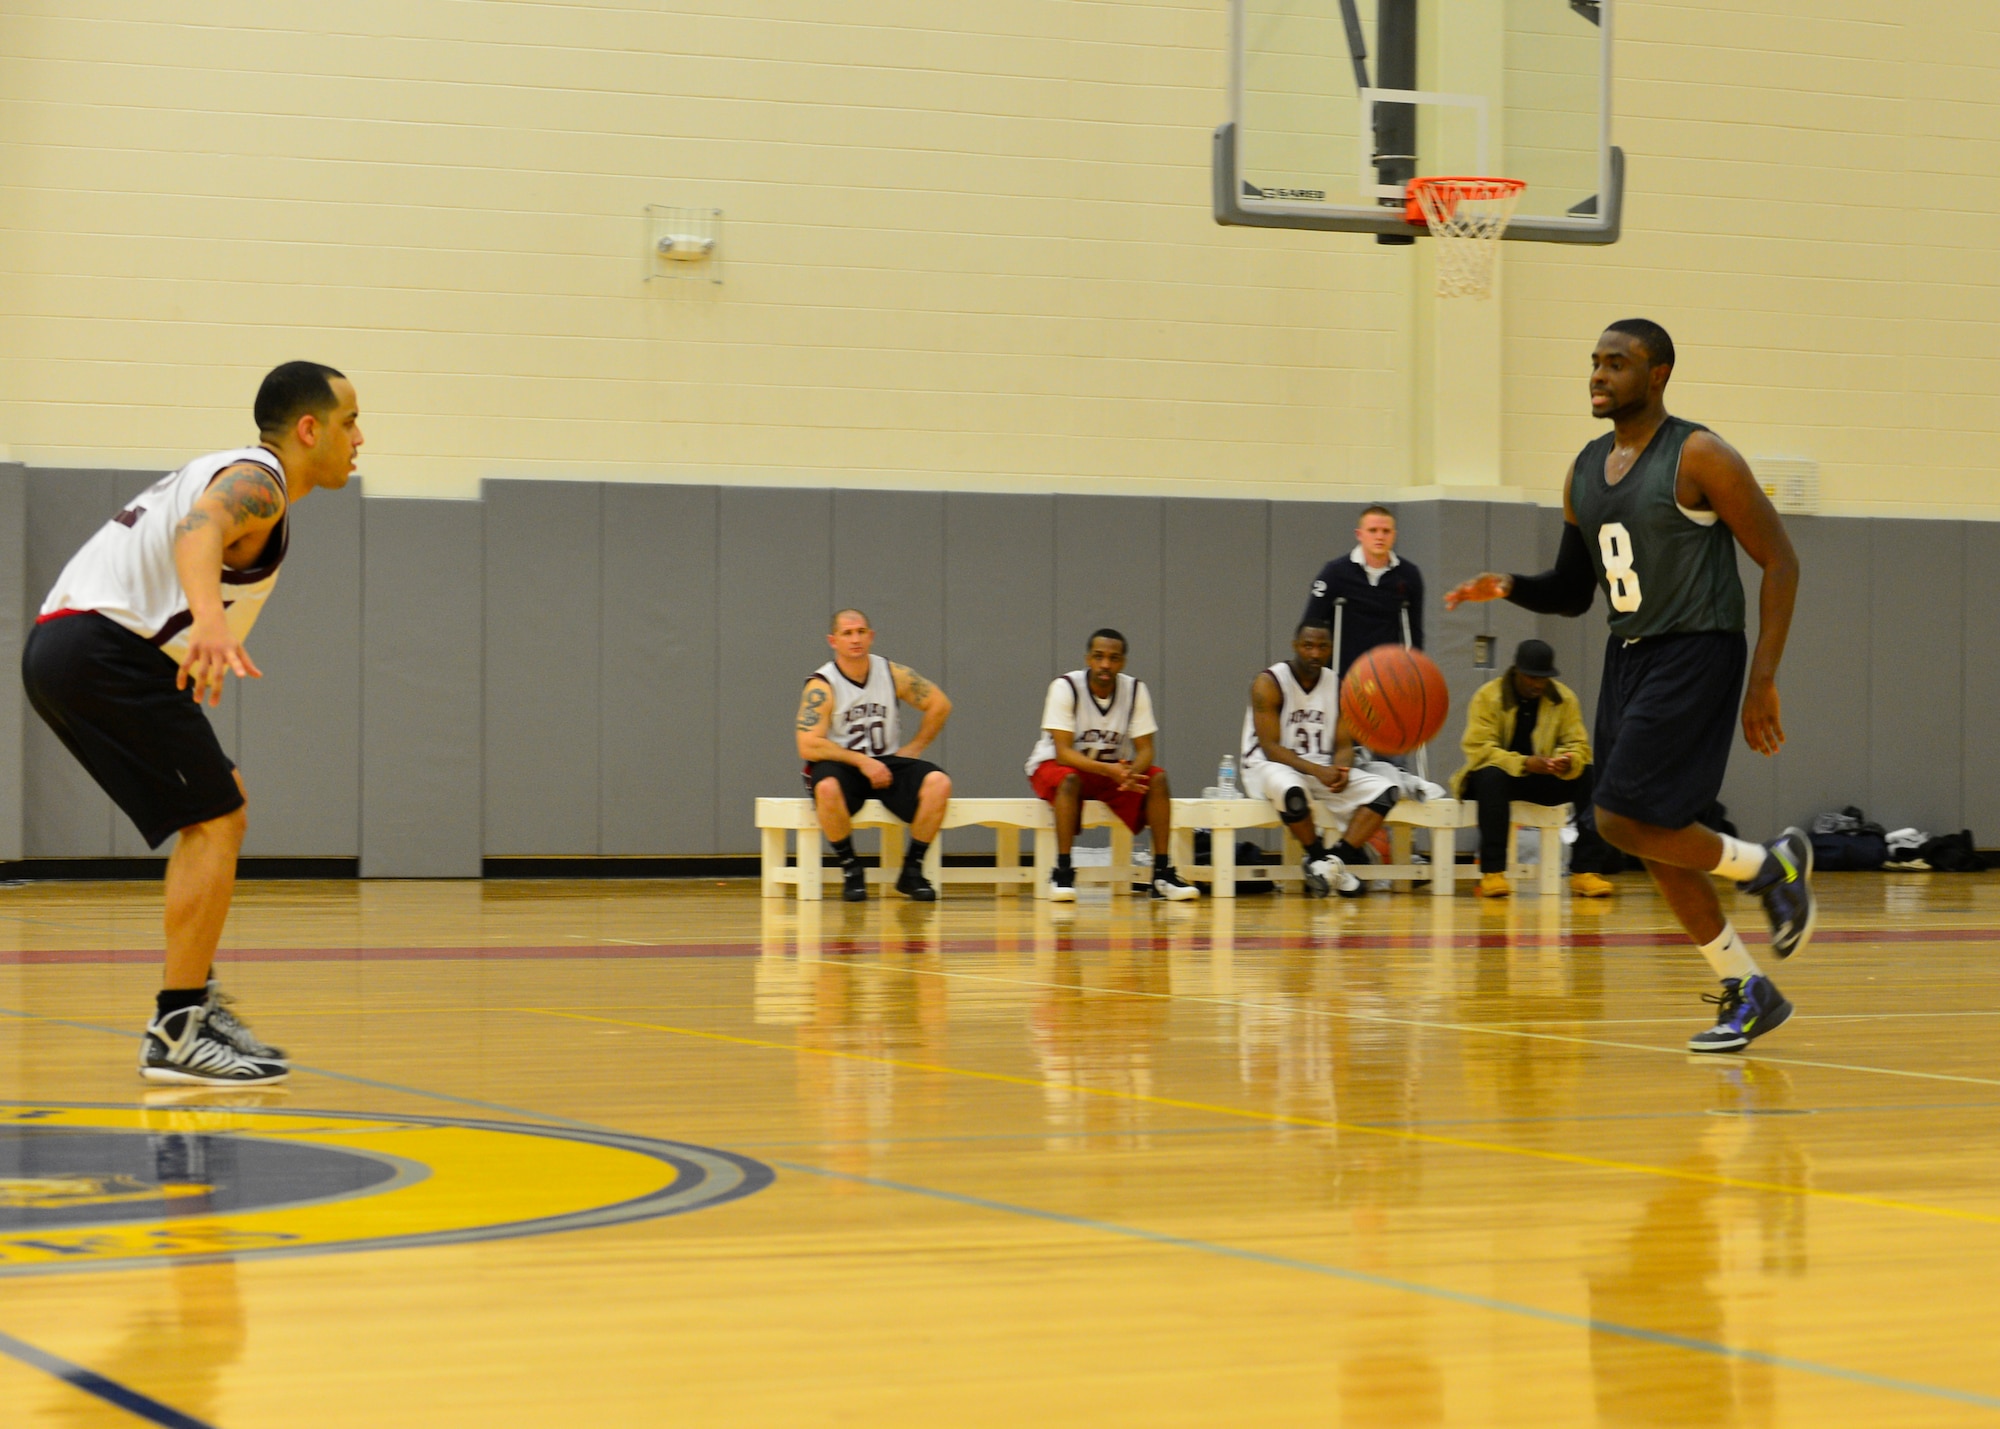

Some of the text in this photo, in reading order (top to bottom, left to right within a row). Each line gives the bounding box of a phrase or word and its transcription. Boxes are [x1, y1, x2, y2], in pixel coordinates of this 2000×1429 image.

[1598, 522, 1642, 613] 8
[1311, 580, 1328, 598] 2
[848, 721, 886, 755] 20
[1295, 727, 1332, 755] 31
